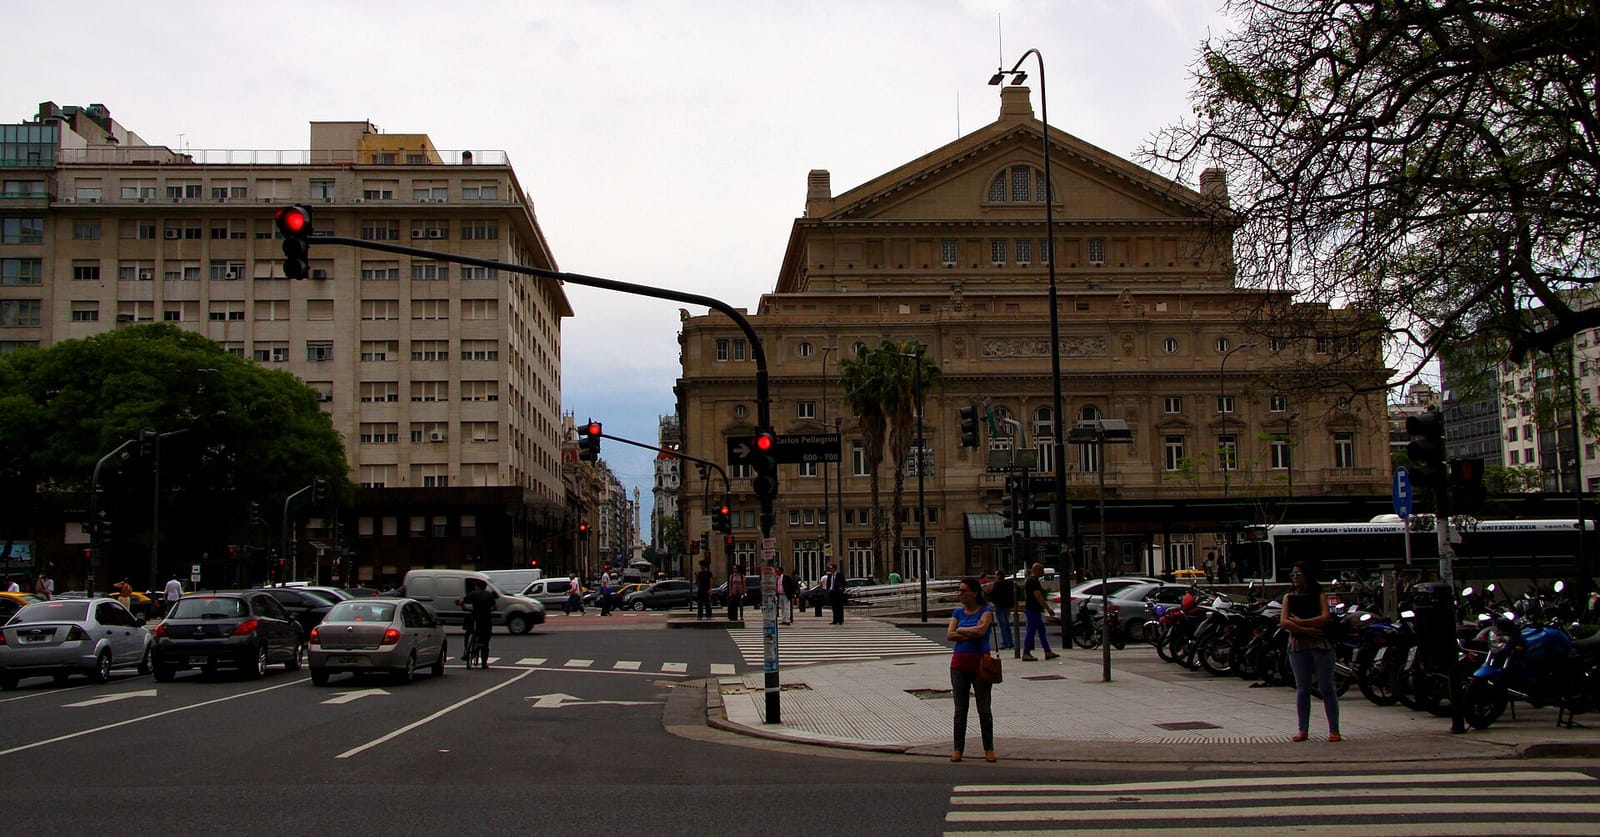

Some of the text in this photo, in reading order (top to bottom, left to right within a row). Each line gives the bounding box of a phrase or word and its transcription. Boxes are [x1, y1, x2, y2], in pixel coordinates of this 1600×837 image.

[801, 434, 838, 445] Pellegrini
[803, 453, 817, 461] 600
[825, 453, 838, 461] 700
[1397, 470, 1407, 498] E
